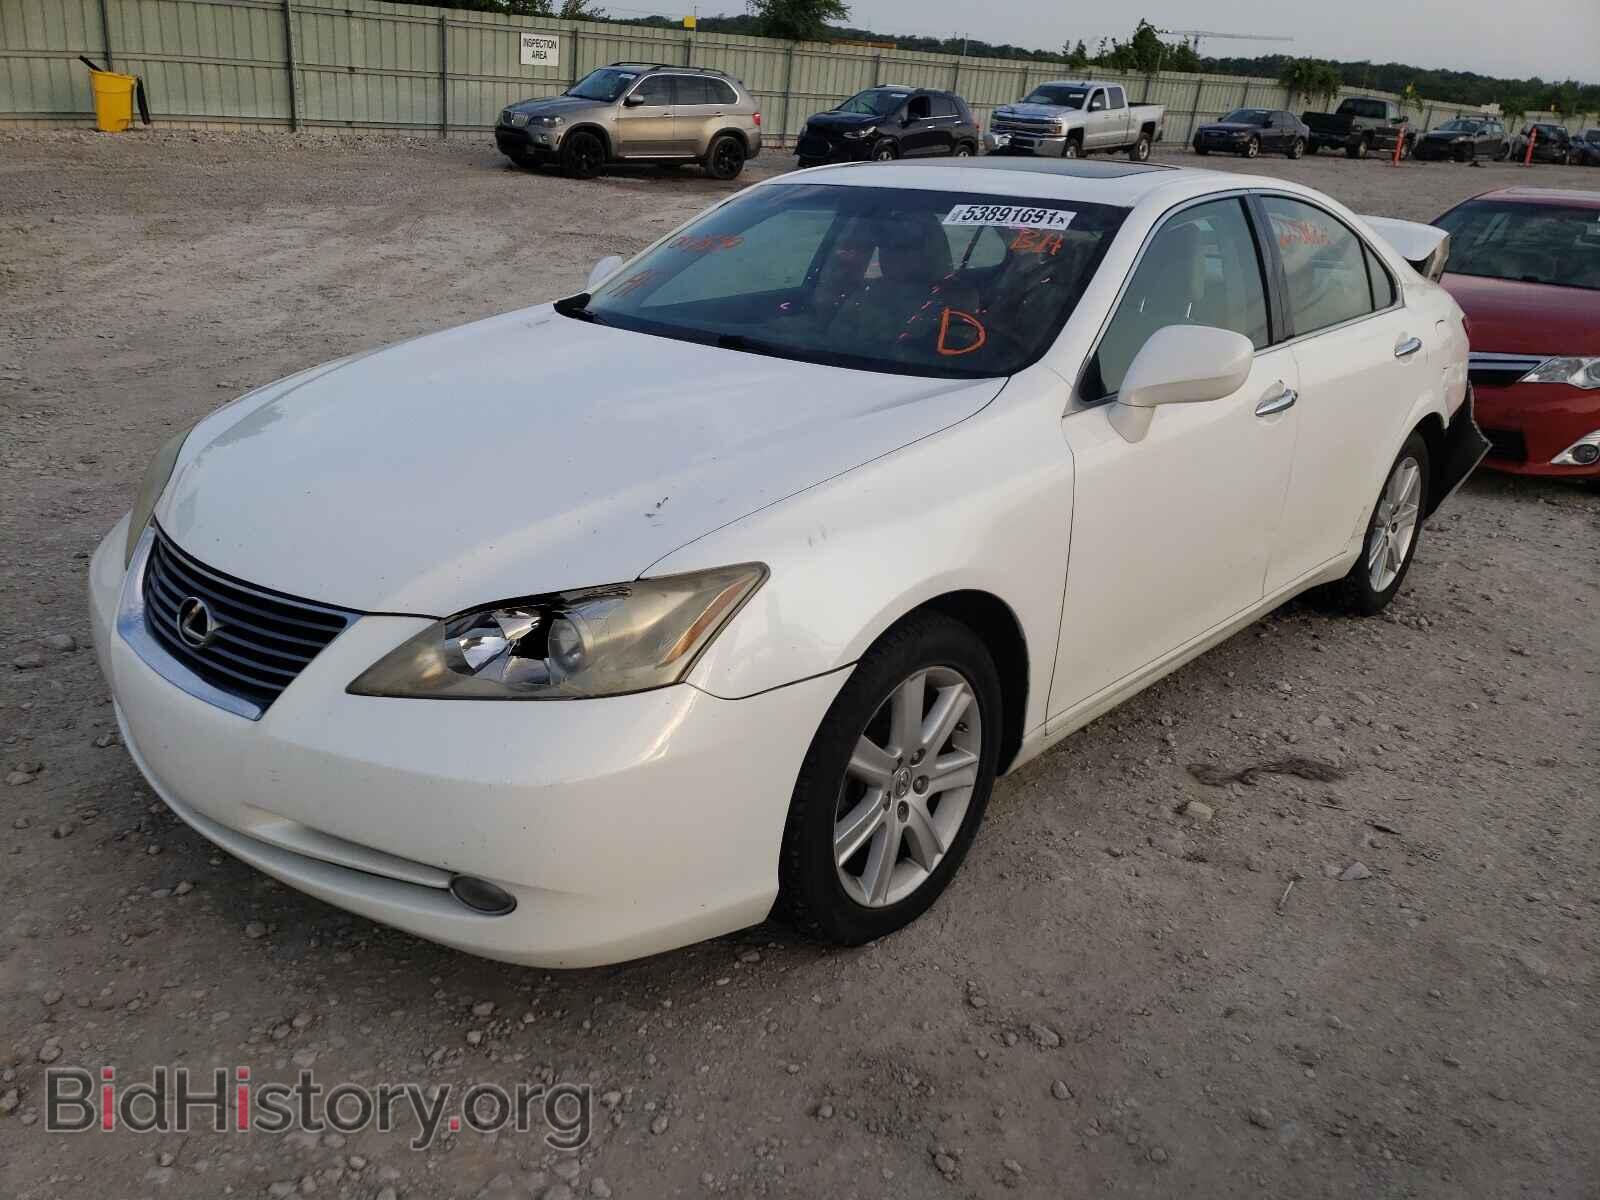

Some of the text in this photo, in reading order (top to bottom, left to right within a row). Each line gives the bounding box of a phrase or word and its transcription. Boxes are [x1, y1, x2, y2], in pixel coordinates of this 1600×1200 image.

[523, 38, 557, 49] INSPECTION
[532, 50, 547, 60] AREA
[962, 206, 1058, 225] 53891691
[937, 307, 986, 356] D
